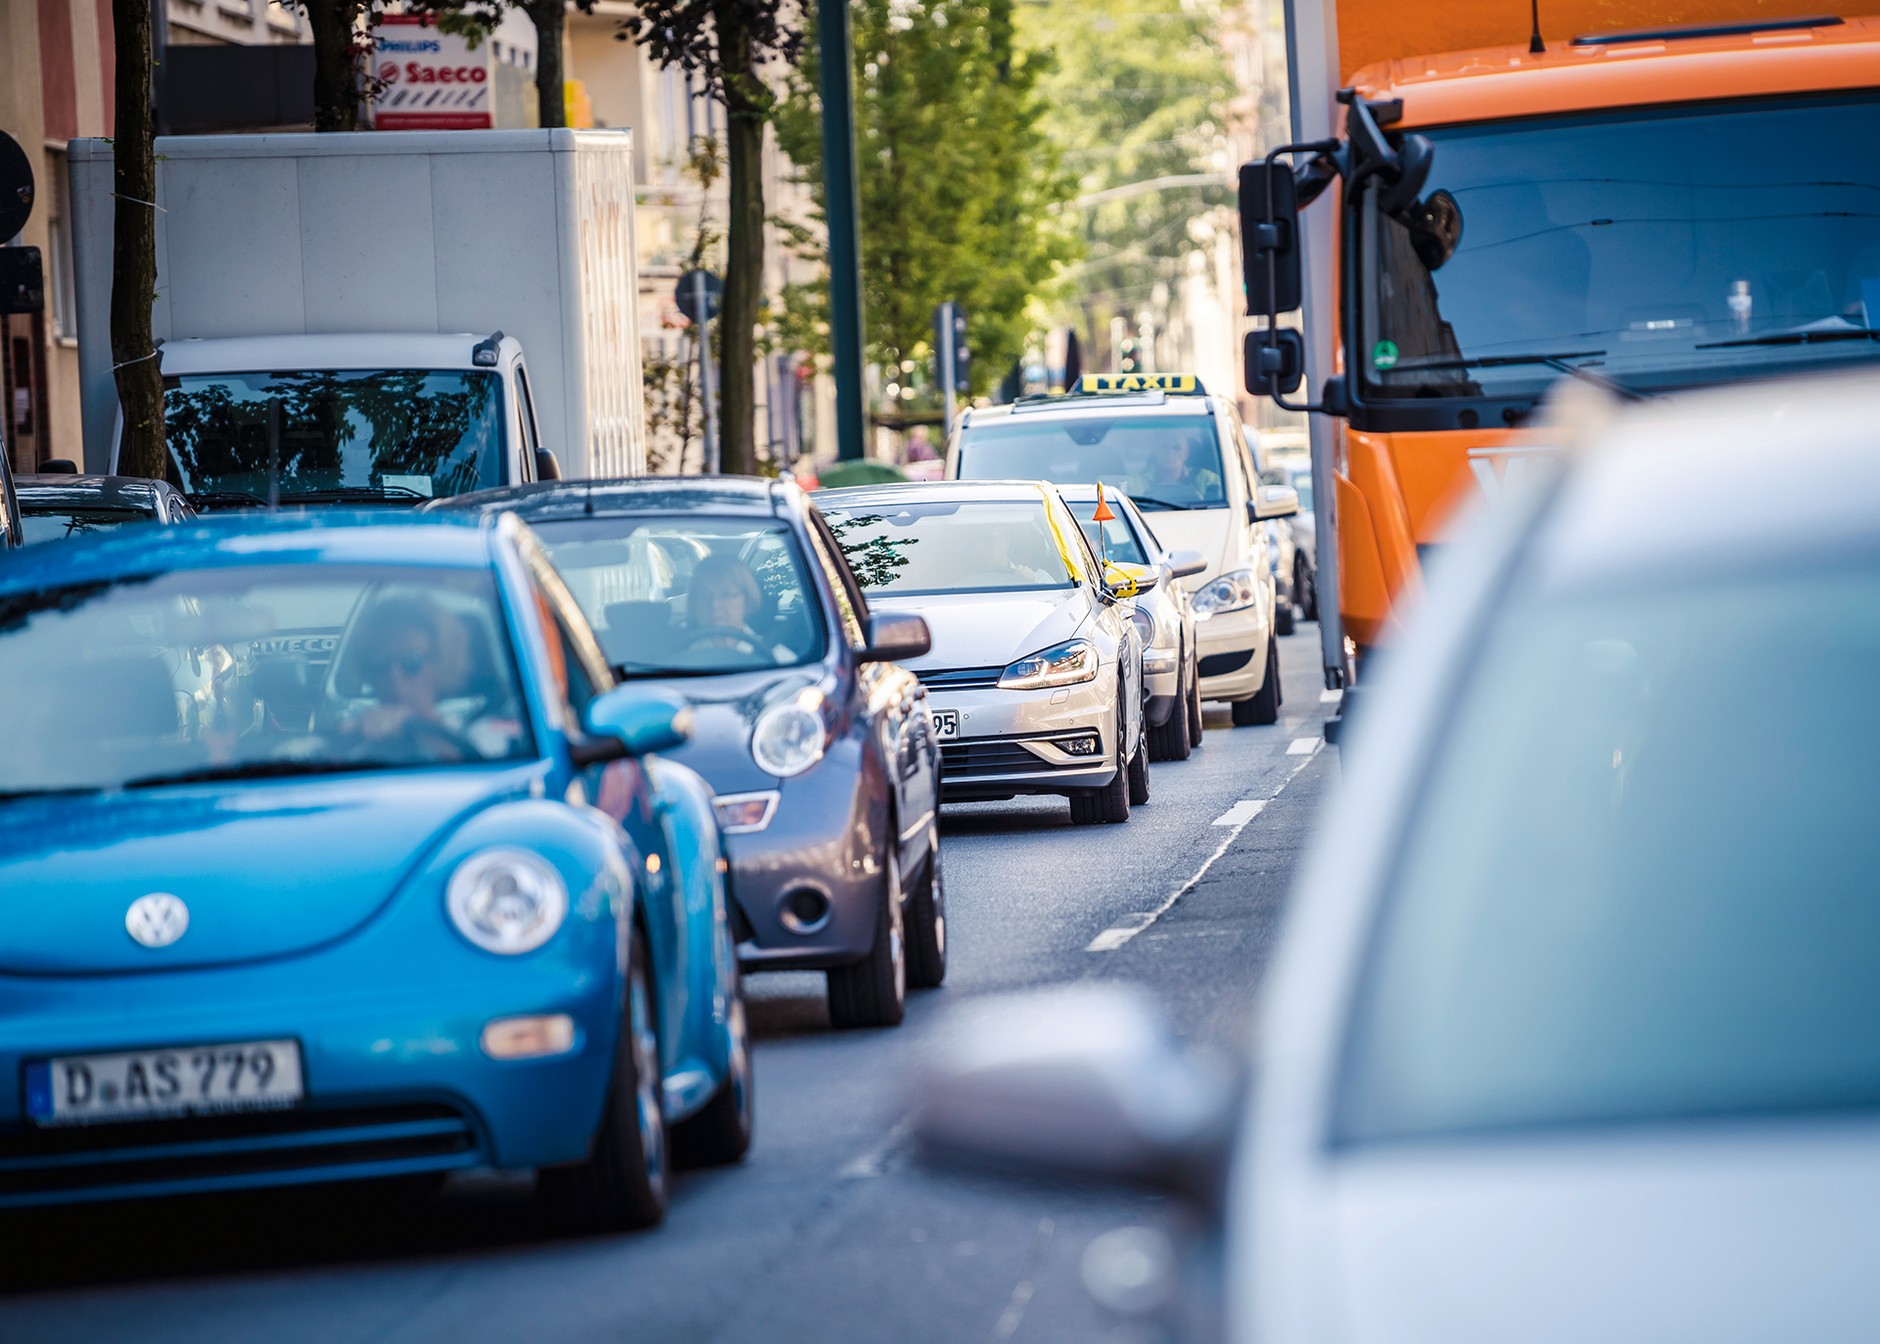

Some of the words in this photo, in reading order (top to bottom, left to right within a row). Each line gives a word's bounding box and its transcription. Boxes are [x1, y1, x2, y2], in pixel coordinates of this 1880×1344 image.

[379, 39, 441, 53] PHILIPS
[405, 61, 488, 84] Saeco
[1103, 375, 1173, 390] TAXI
[260, 638, 337, 655] IVECO
[64, 1061, 94, 1106] D
[125, 1052, 181, 1100] AS
[191, 1046, 275, 1092] 779
